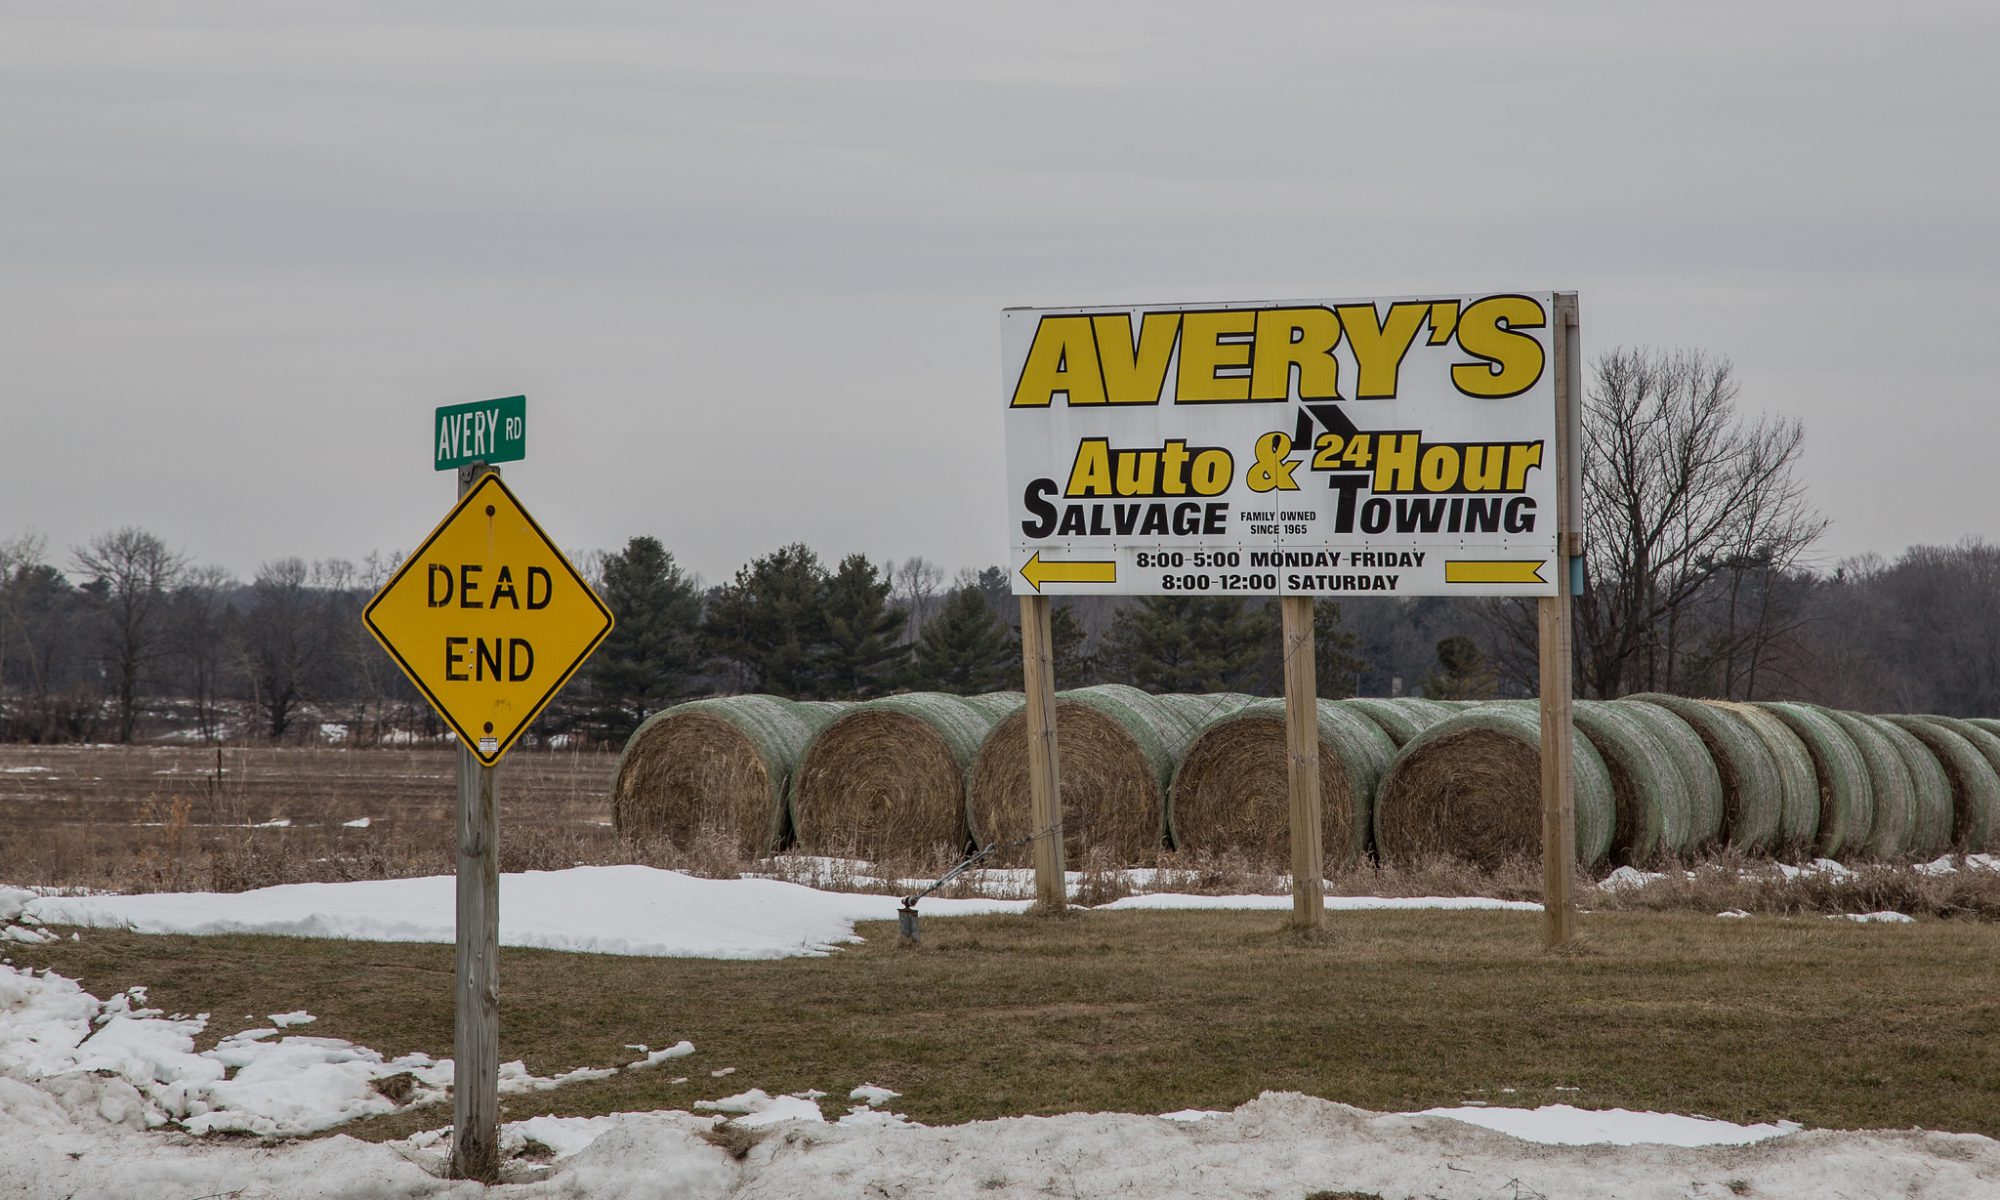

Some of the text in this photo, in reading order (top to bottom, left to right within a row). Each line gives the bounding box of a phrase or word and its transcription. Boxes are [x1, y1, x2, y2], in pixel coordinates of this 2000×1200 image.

[1009, 294, 1547, 408] AVERY'S
[438, 408, 522, 460] AVERY RD
[1064, 437, 1234, 498] Auto
[1246, 431, 1303, 493] &
[1021, 474, 1538, 539] SALVAGE TOWING
[1240, 511, 1317, 522] FAMILY OWNED
[1250, 524, 1308, 535] SINCE 1965
[1136, 552, 1426, 568] 8:00-5:00 MONDAY-FRIDAY
[1161, 574, 1399, 590] 8:00-12:00 SATURDAY
[427, 564, 553, 610] DEAD
[445, 637, 534, 682] END
